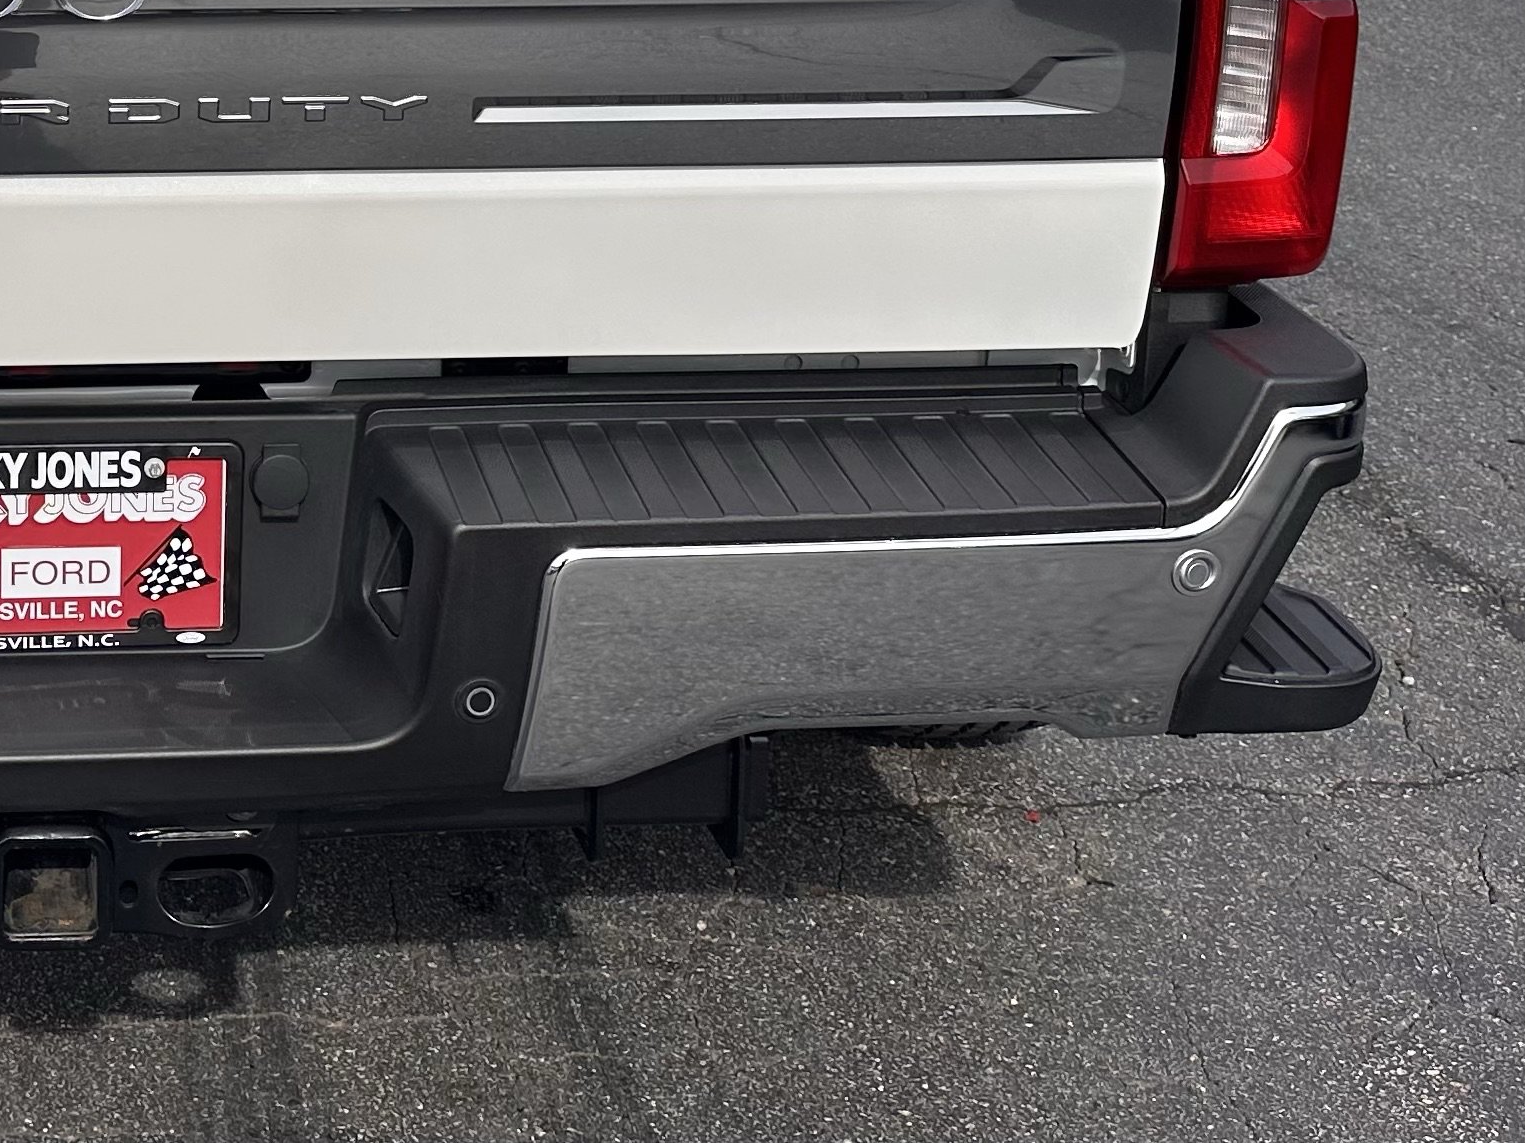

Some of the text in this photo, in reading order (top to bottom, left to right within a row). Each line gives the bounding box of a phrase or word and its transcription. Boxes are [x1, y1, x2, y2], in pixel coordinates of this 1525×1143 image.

[108, 94, 428, 123] DUTY
[31, 450, 142, 490] JONES
[10, 560, 111, 586] FORD
[90, 600, 123, 618] NC
[78, 633, 121, 647] N.C.
